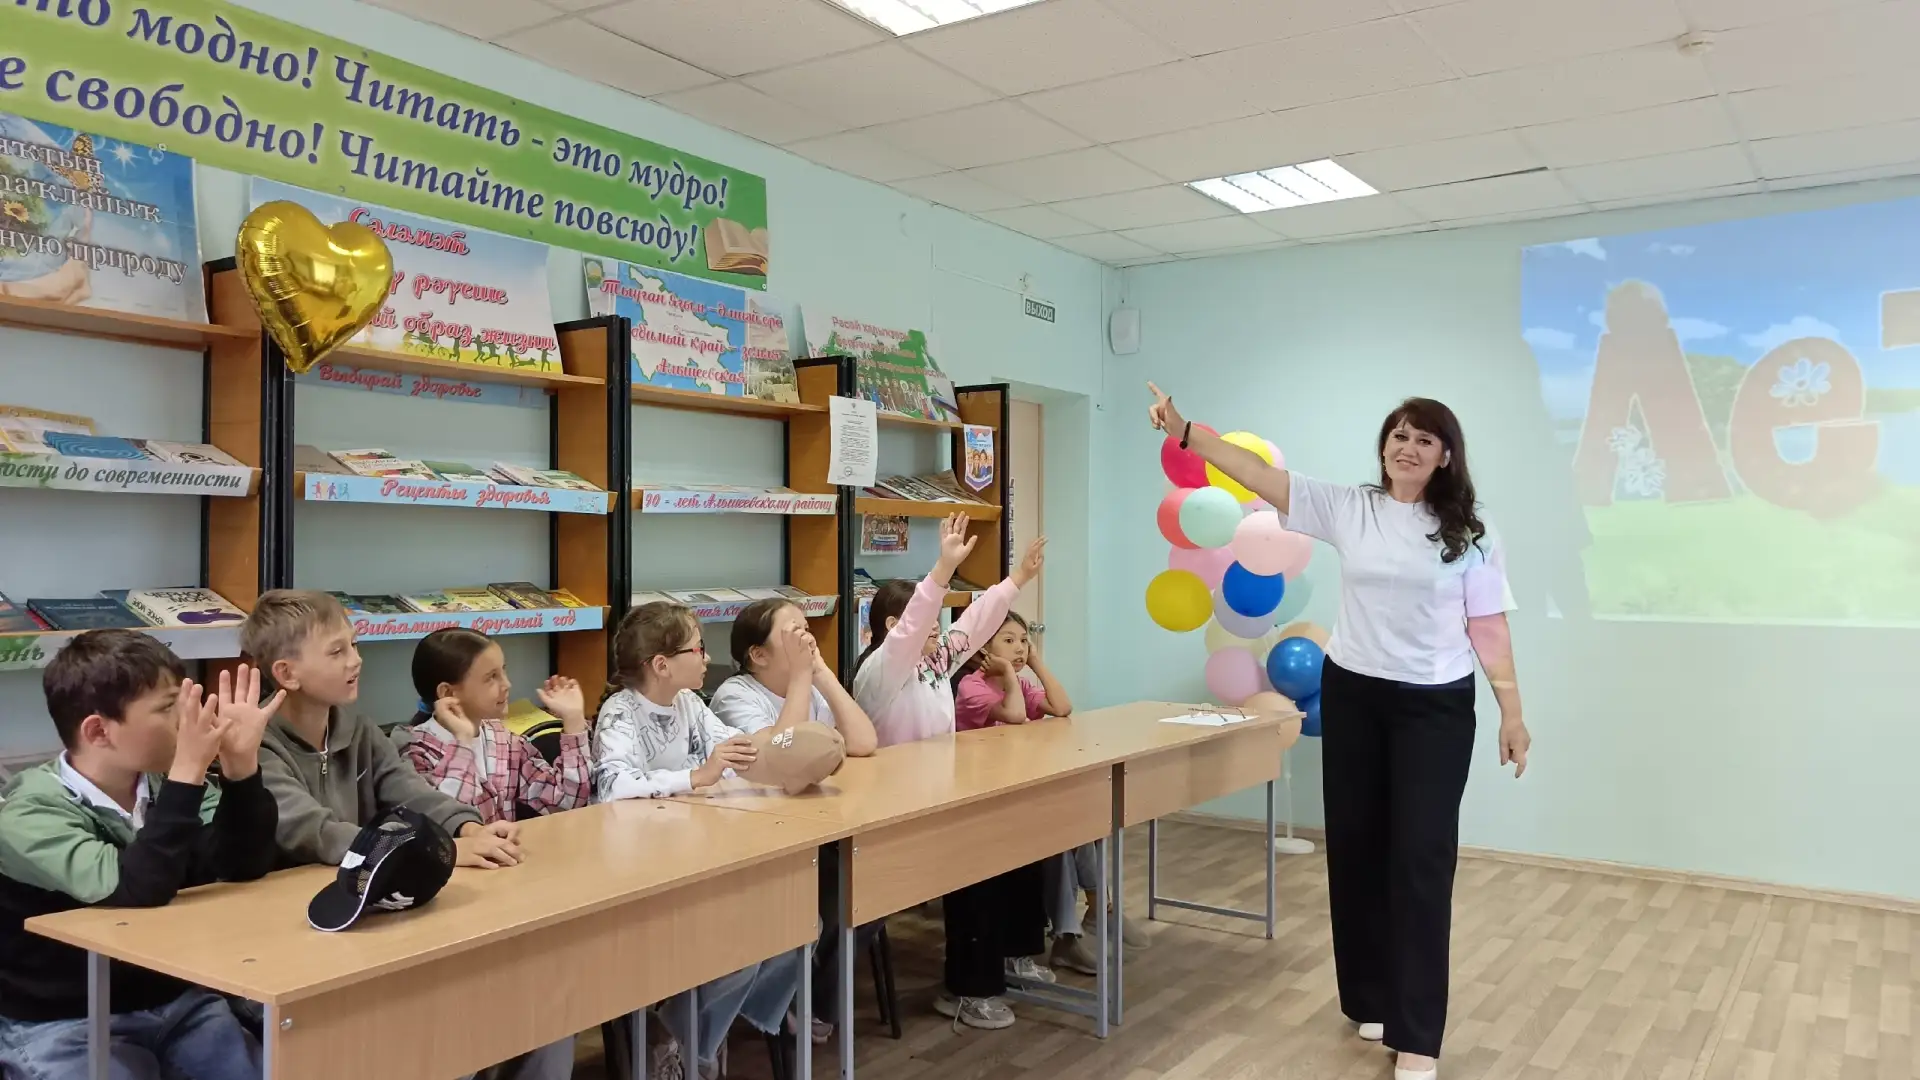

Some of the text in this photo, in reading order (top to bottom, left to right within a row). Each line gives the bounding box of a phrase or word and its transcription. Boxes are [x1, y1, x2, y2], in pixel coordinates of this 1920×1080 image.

[126, 8, 319, 89] модно!
[334, 55, 521, 147] Читать
[553, 136, 621, 177] это
[628, 160, 729, 210] мудро!
[46, 69, 324, 163] свободно!
[340, 130, 544, 218] Читайте
[555, 201, 698, 262] повсюду!
[0, 229, 188, 285] ную природу
[1026, 300, 1054, 321] ВЫХОД
[402, 311, 473, 347] образ
[481, 328, 557, 355] жизни
[631, 324, 686, 348] одимый
[690, 335, 725, 357] край
[319, 363, 482, 400] Выбирай здоровье
[0, 461, 242, 490] ости до современности
[380, 478, 467, 501] Рецепты
[475, 487, 551, 508] здоровья
[673, 494, 701, 508] лет
[792, 497, 832, 513] району
[353, 618, 460, 637] Витамины
[552, 609, 576, 627] год
